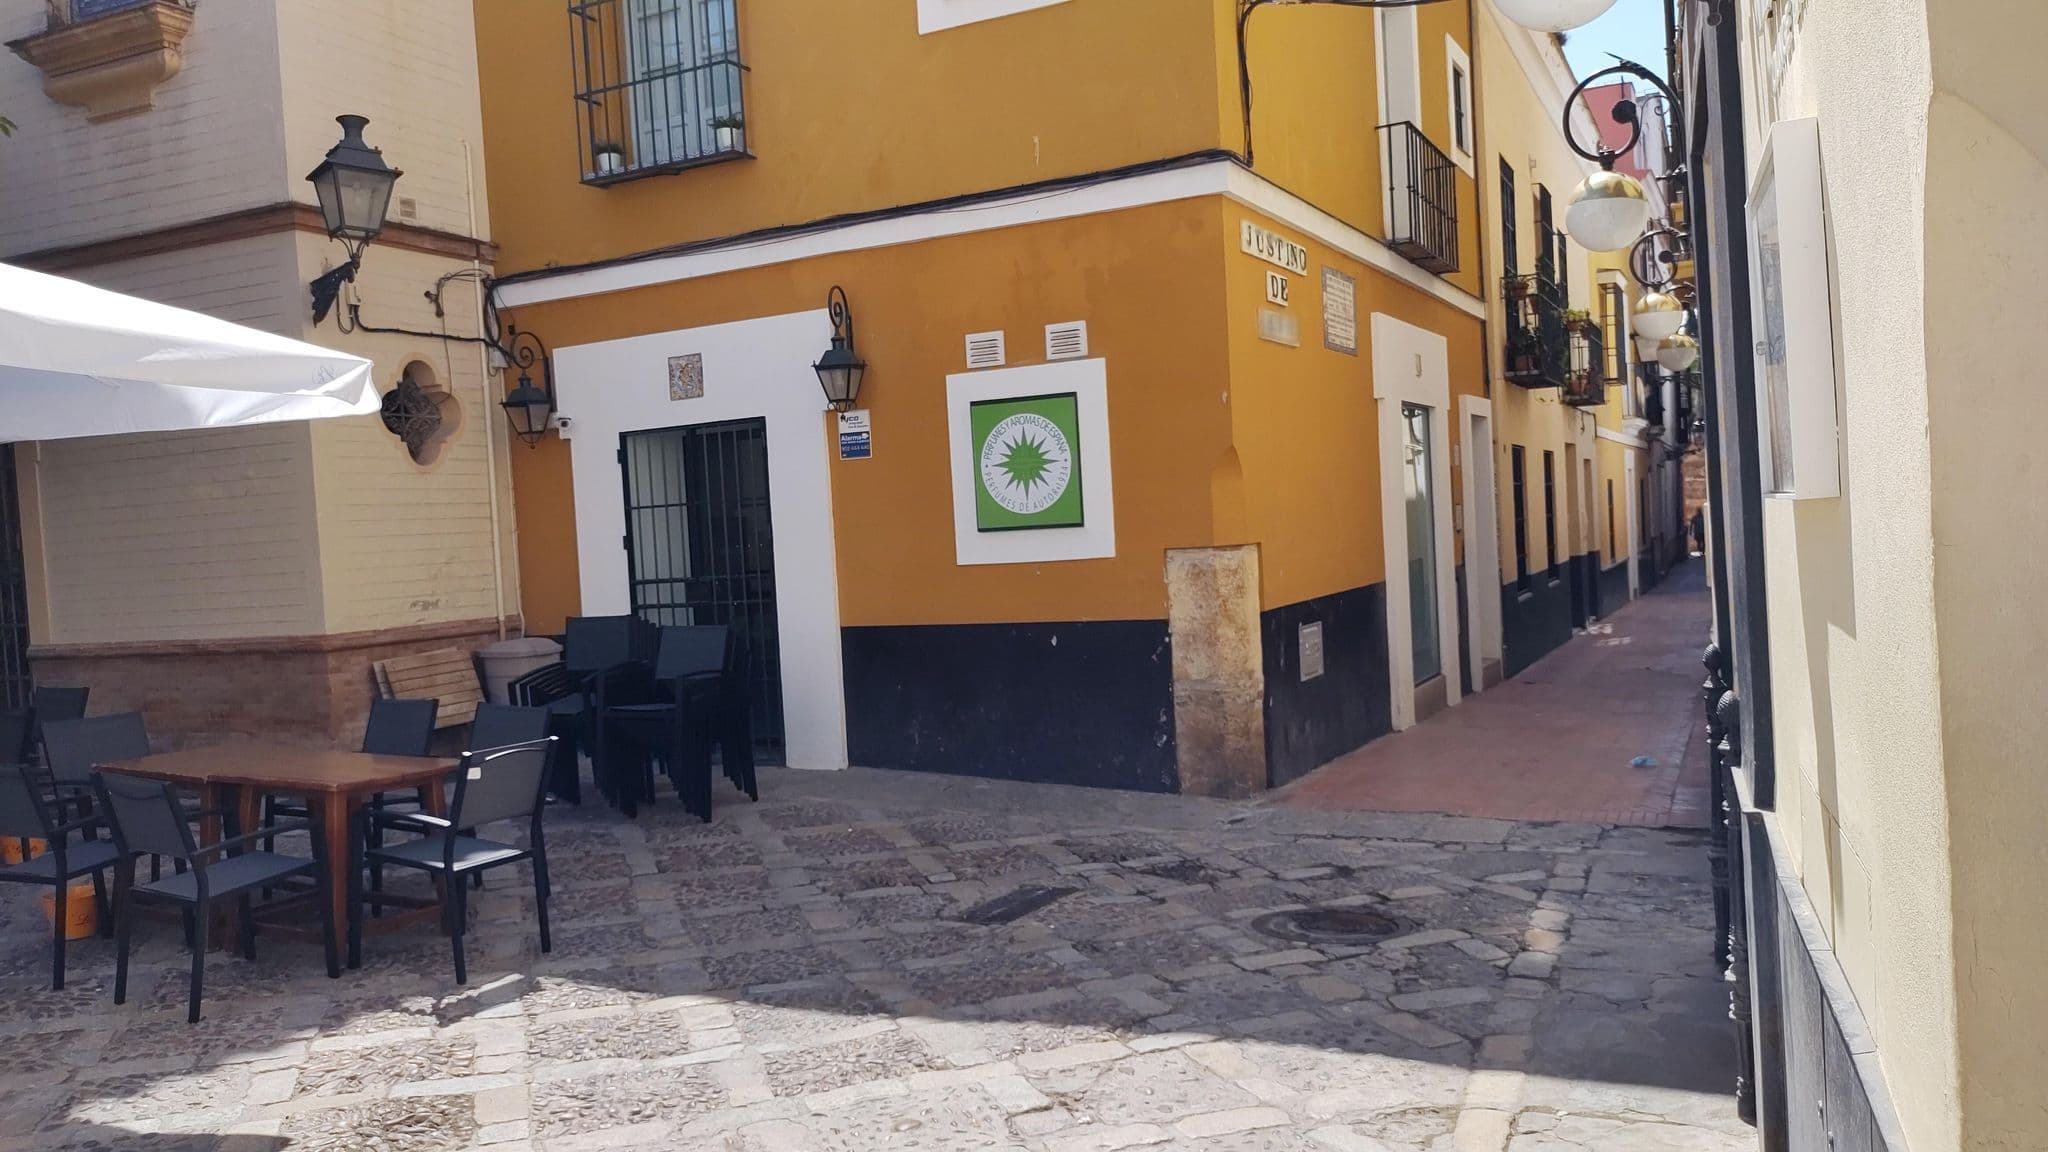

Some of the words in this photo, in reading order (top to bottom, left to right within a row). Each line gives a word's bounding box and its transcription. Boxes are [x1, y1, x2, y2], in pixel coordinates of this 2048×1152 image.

[1248, 225, 1307, 271] JUSTINO
[1270, 275, 1288, 301] DE
[984, 424, 1007, 460] PERFUMES
[1010, 415, 1041, 427] AROMAS
[984, 471, 1015, 510] PERFUMES
[1019, 502, 1029, 511] DE
